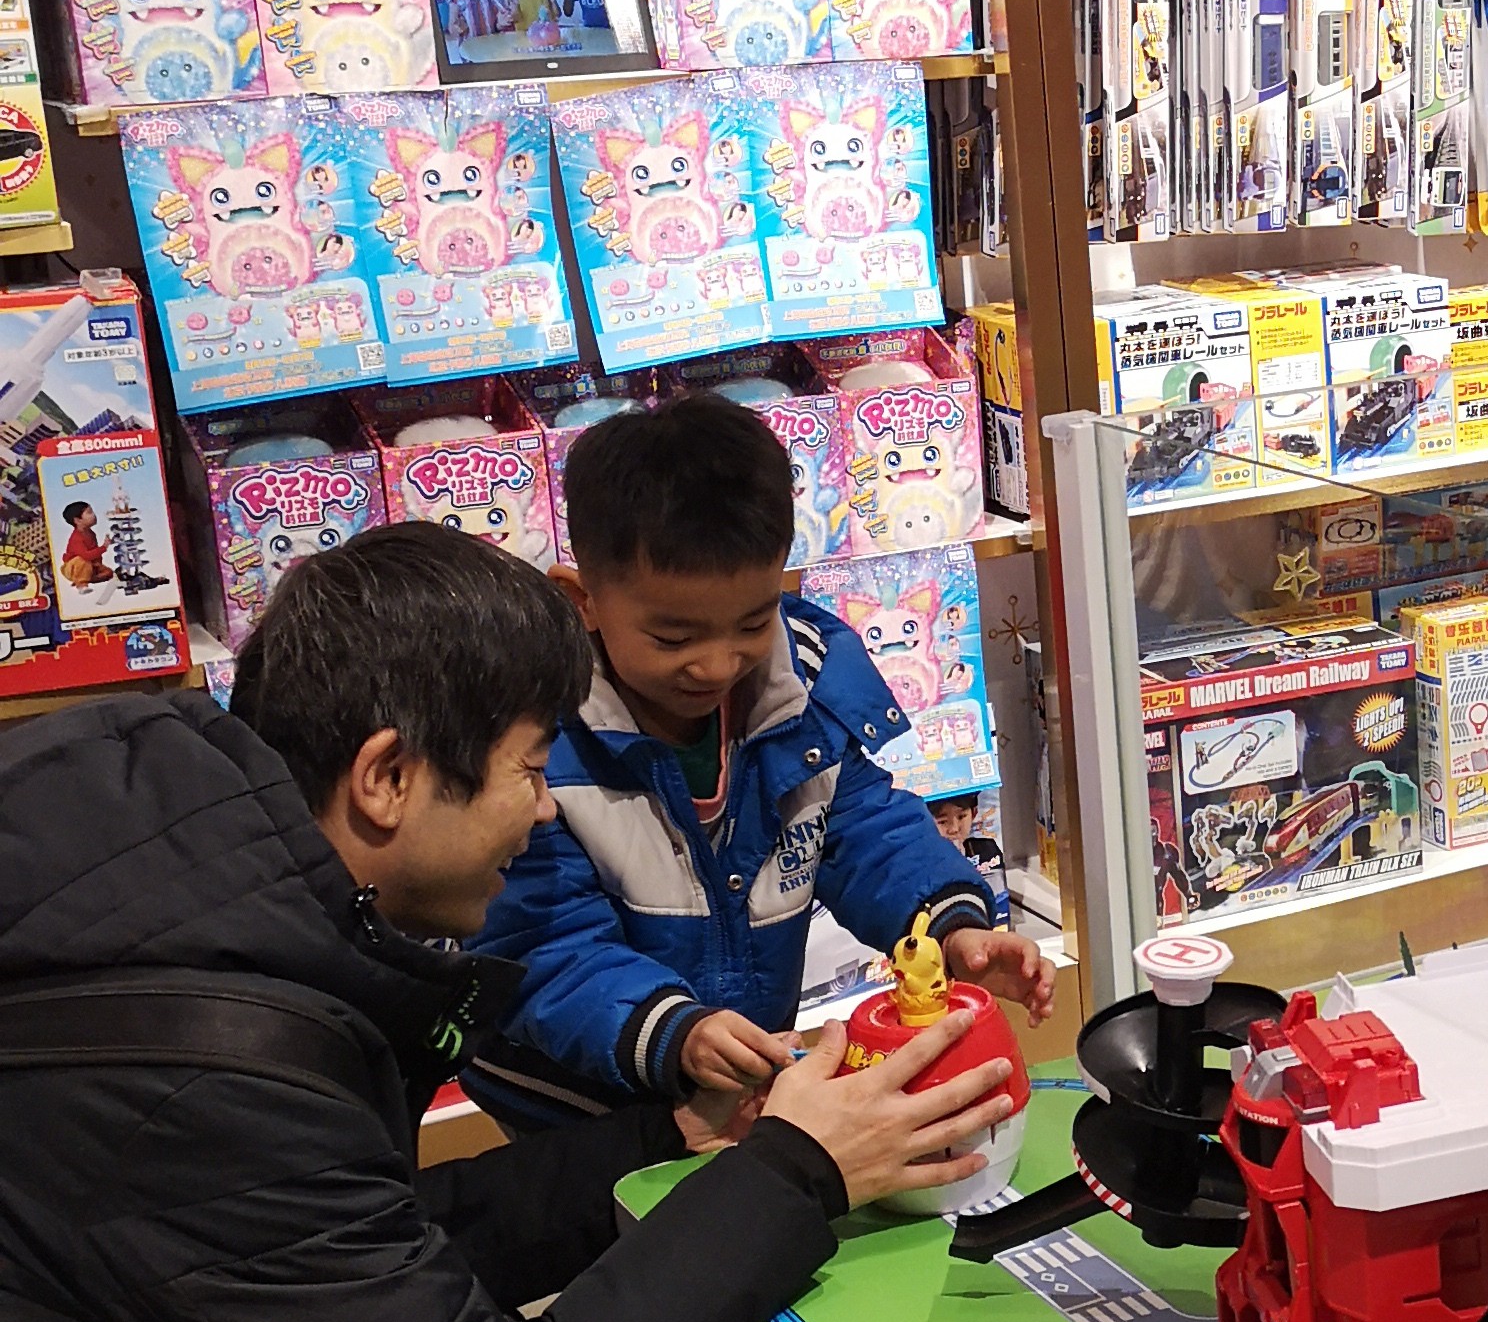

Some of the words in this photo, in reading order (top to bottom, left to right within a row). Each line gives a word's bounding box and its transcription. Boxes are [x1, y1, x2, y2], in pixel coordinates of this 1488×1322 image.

[1253, 303, 1308, 321] プラレール
[1330, 307, 1405, 327] 丸太を運ぼう!
[93, 328, 127, 338] TOMY
[1120, 333, 1201, 355] 丸太を運ぼう!
[862, 391, 952, 431] Rizmo
[56, 436, 144, 455] 全高800mm!
[411, 451, 520, 493] Rizmo
[239, 475, 352, 513] Rizmo
[1380, 658, 1407, 670] TOMY
[1190, 683, 1253, 709] MARVEL
[1254, 671, 1308, 698] Dream
[1309, 659, 1371, 688] Railway
[1356, 711, 1387, 734] LIGHTS
[1301, 868, 1349, 889] IRONMAN
[1349, 861, 1381, 880] TRAIN
[1399, 851, 1421, 870] SET
